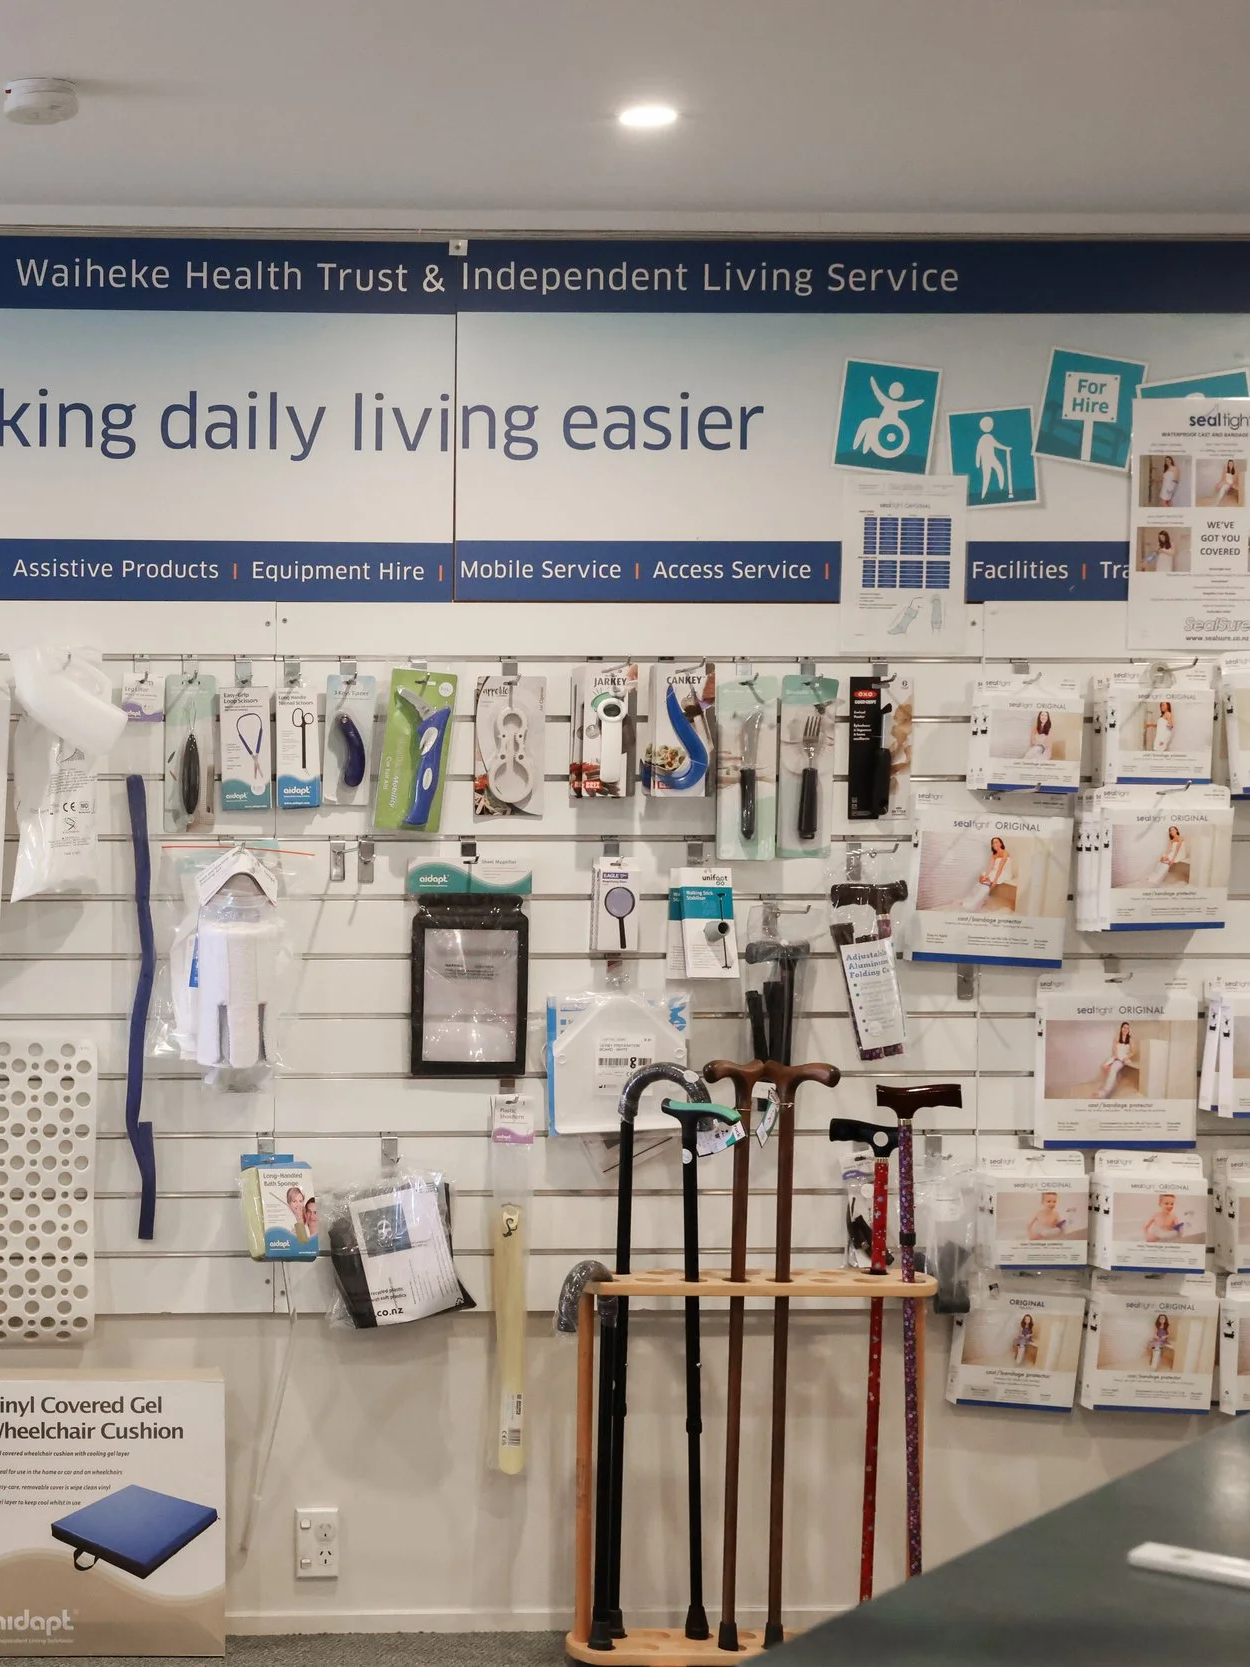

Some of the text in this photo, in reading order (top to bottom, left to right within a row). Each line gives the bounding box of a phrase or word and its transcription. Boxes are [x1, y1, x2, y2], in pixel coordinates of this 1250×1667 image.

[16, 257, 960, 297] Waiheke Health Trust & Independent Living Service
[1077, 379, 1108, 396] For
[1072, 396, 1110, 415] Hire
[159, 390, 327, 462] daily
[352, 391, 540, 462] living
[562, 391, 765, 452] easier
[1190, 412, 1250, 430] sealtigh
[1200, 534, 1240, 542] GOT YOU
[1200, 548, 1241, 556] COVERED
[13, 557, 114, 578] Assistive
[121, 558, 220, 579] Products
[252, 560, 371, 584] Equipment
[378, 561, 425, 581] Hire
[460, 559, 534, 580] Mobile
[542, 559, 622, 579] Service
[653, 560, 725, 580] Access
[732, 559, 812, 580] Service
[972, 561, 1069, 580] Facilities
[594, 677, 627, 687] JARKEY
[666, 676, 702, 686] CANKEY
[586, 781, 600, 789] BRIX
[284, 786, 312, 796] aidapt
[389, 776, 399, 808] Mobility
[995, 822, 1041, 832] ORIGINAL
[419, 874, 448, 884] aidapt
[850, 970, 880, 978] Folding
[1118, 1006, 1164, 1014] ORIGINAL
[270, 1240, 290, 1248] aidapt
[1010, 1299, 1045, 1308] ORIGINAL
[1159, 1302, 1196, 1311] ORIGINAL
[375, 1307, 404, 1318] .co.nz
[40, 1396, 124, 1414] Covered
[130, 1396, 162, 1414] Gel
[100, 1422, 184, 1440] Cushion
